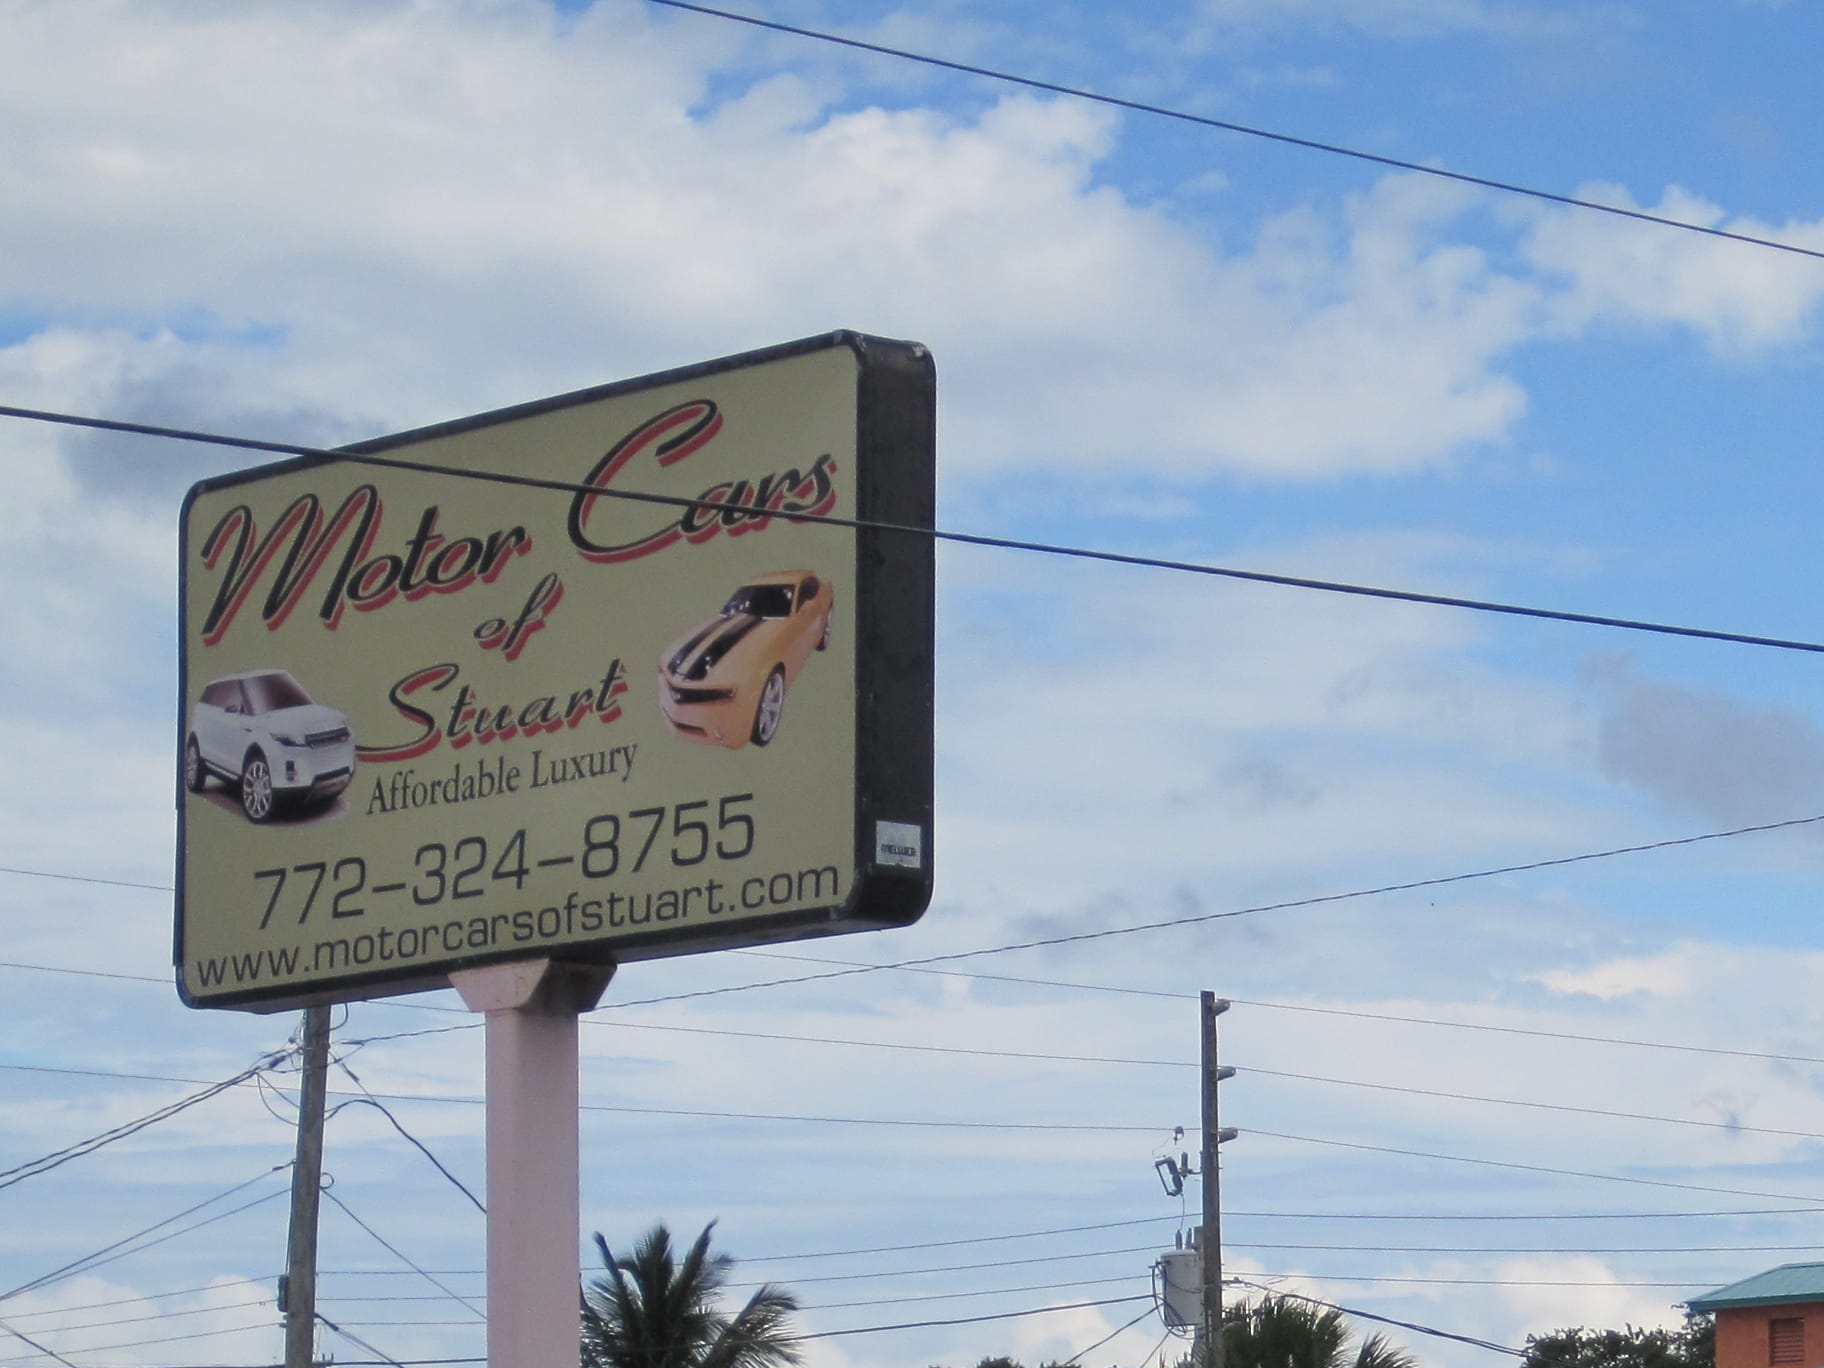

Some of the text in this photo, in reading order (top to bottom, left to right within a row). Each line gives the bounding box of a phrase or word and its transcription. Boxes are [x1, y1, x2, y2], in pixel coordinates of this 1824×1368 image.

[201, 400, 837, 646] Motor Cars
[473, 572, 564, 662] of
[354, 659, 629, 762] Stuart
[366, 743, 639, 815] Affordable Luxury
[253, 793, 754, 930] 772-324-8755
[198, 865, 839, 989] www.motorcarsofstuart.com
